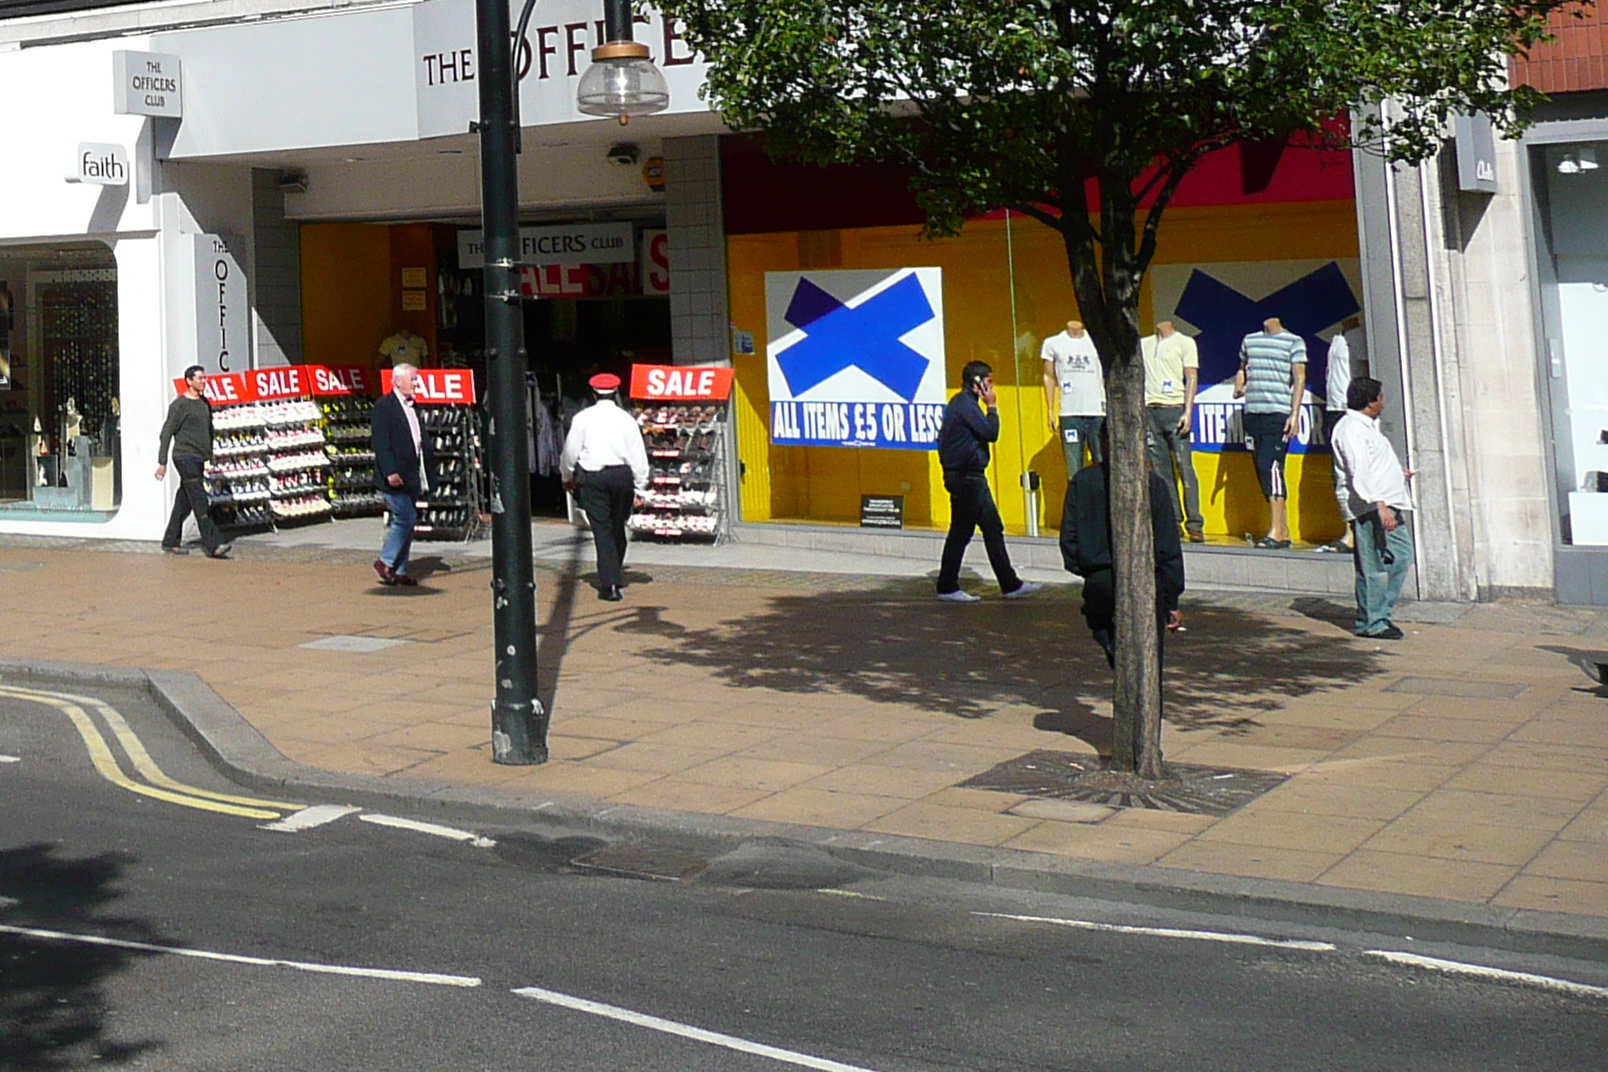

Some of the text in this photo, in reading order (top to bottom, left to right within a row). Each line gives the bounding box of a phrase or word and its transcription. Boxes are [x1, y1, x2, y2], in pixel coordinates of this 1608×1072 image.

[147, 61, 162, 73] THE
[423, 49, 475, 86] THE
[132, 76, 176, 92] OFFICERS
[145, 95, 166, 107] CLUB
[83, 151, 123, 179] faith
[213, 240, 230, 253] THE
[468, 234, 623, 255] TH FICERS CLUB
[522, 266, 584, 295] ALE
[215, 259, 230, 373] OFFIC
[202, 377, 238, 402] ALE
[256, 369, 300, 397] SALE
[317, 368, 364, 391] SALE
[414, 374, 464, 399] ALE
[647, 369, 715, 396] SALE
[774, 402, 944, 443] ALL ITEMS £5 OR LESS
[1198, 404, 1326, 445] ITEM OR
